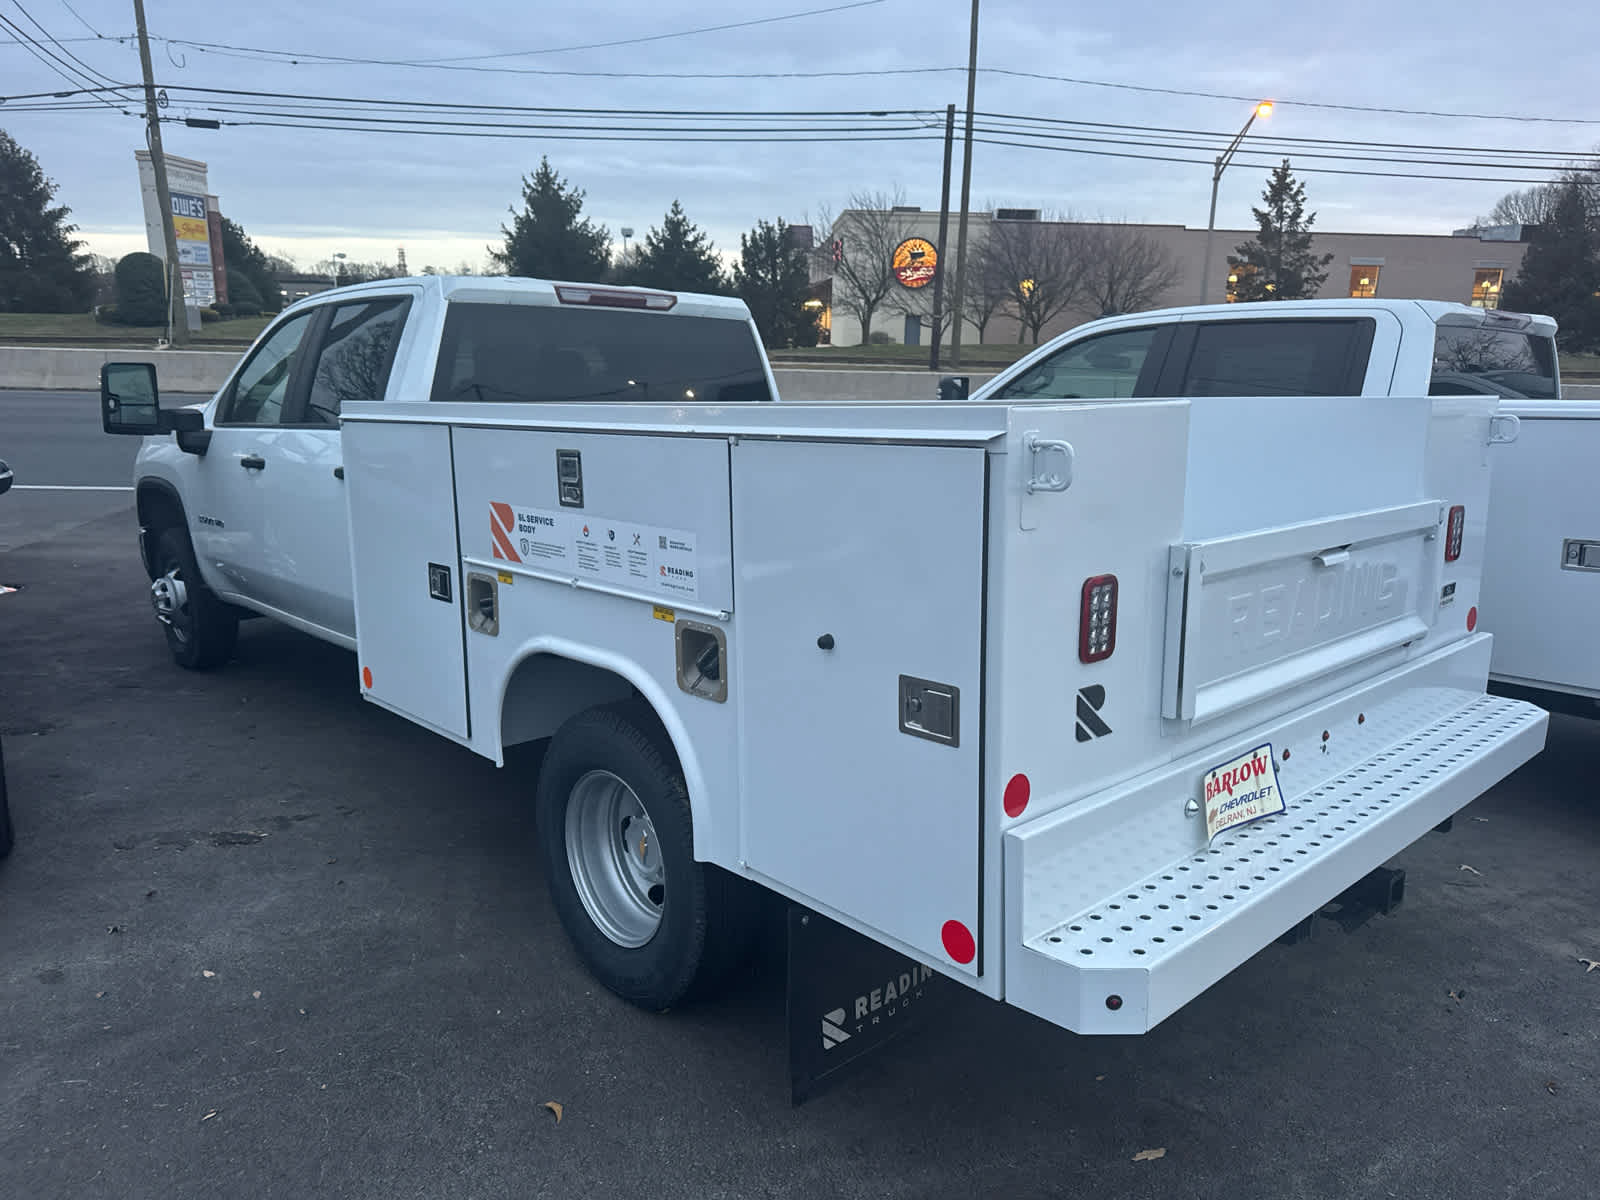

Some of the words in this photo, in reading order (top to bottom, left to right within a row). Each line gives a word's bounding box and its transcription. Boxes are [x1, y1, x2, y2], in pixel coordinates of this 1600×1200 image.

[171, 197, 205, 218] OWE'S
[518, 523, 536, 535] BODY
[527, 514, 555, 527] SERVICE
[667, 566, 694, 578] READING
[1206, 755, 1268, 803] BARLOW
[1219, 785, 1273, 814] CHEVROLET
[1246, 804, 1257, 816] NJ
[855, 964, 932, 1020] READIN
